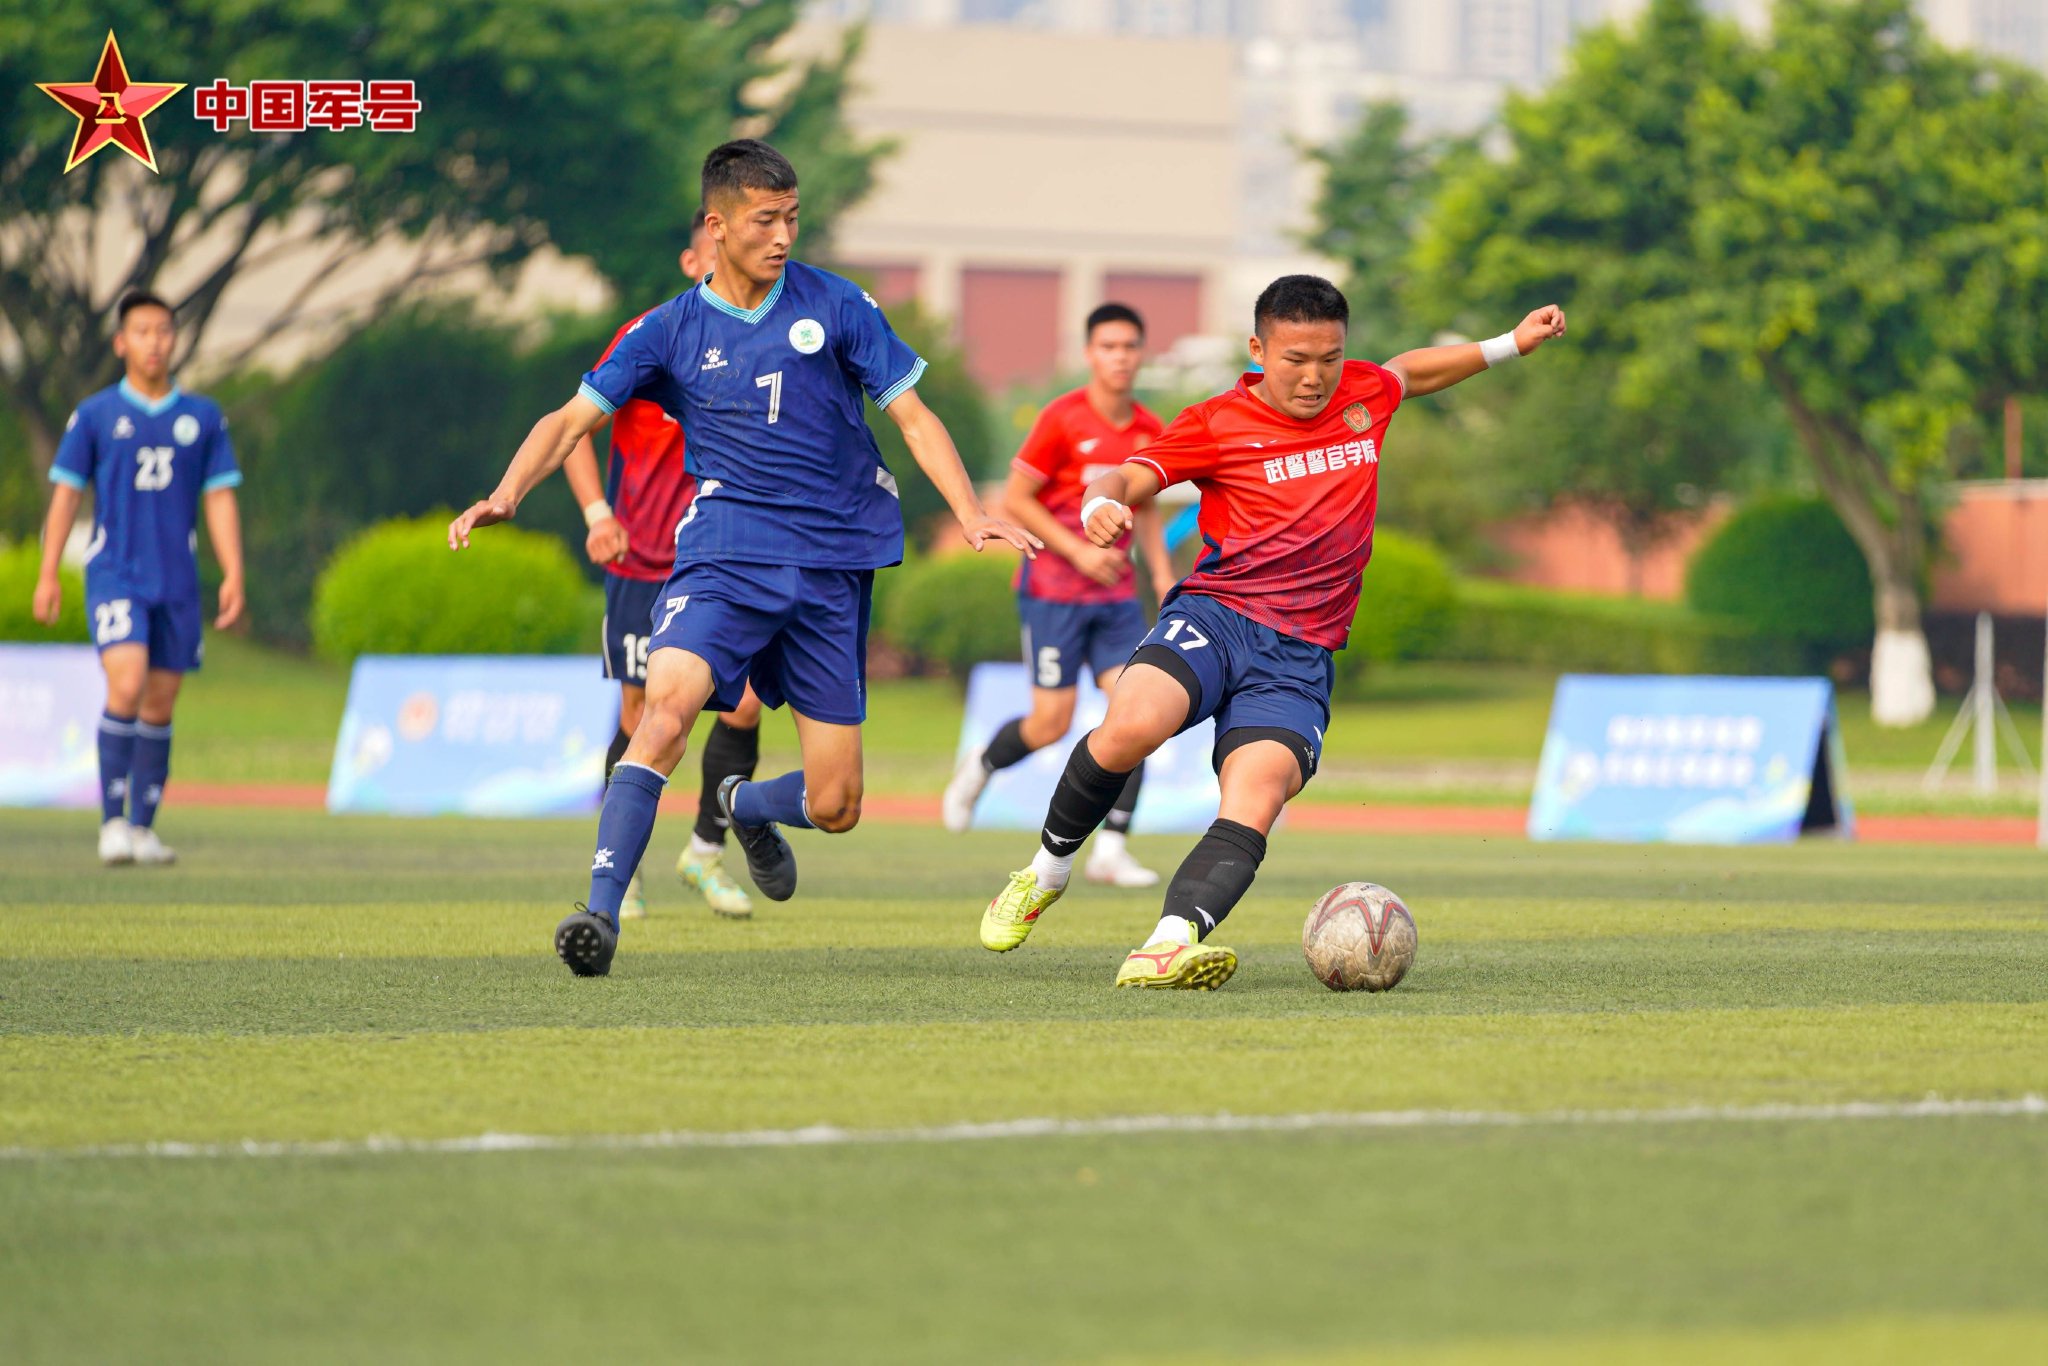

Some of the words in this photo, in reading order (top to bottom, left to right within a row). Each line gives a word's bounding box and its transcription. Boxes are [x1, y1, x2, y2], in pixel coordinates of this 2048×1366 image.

[701, 360, 729, 370] KELME
[755, 371, 783, 424] 7
[135, 447, 175, 491] 23
[1263, 438, 1378, 484] 武警警官学院
[95, 599, 133, 646] 23
[655, 595, 690, 636] 7
[1163, 619, 1209, 651] 17
[1038, 646, 1062, 688] 5
